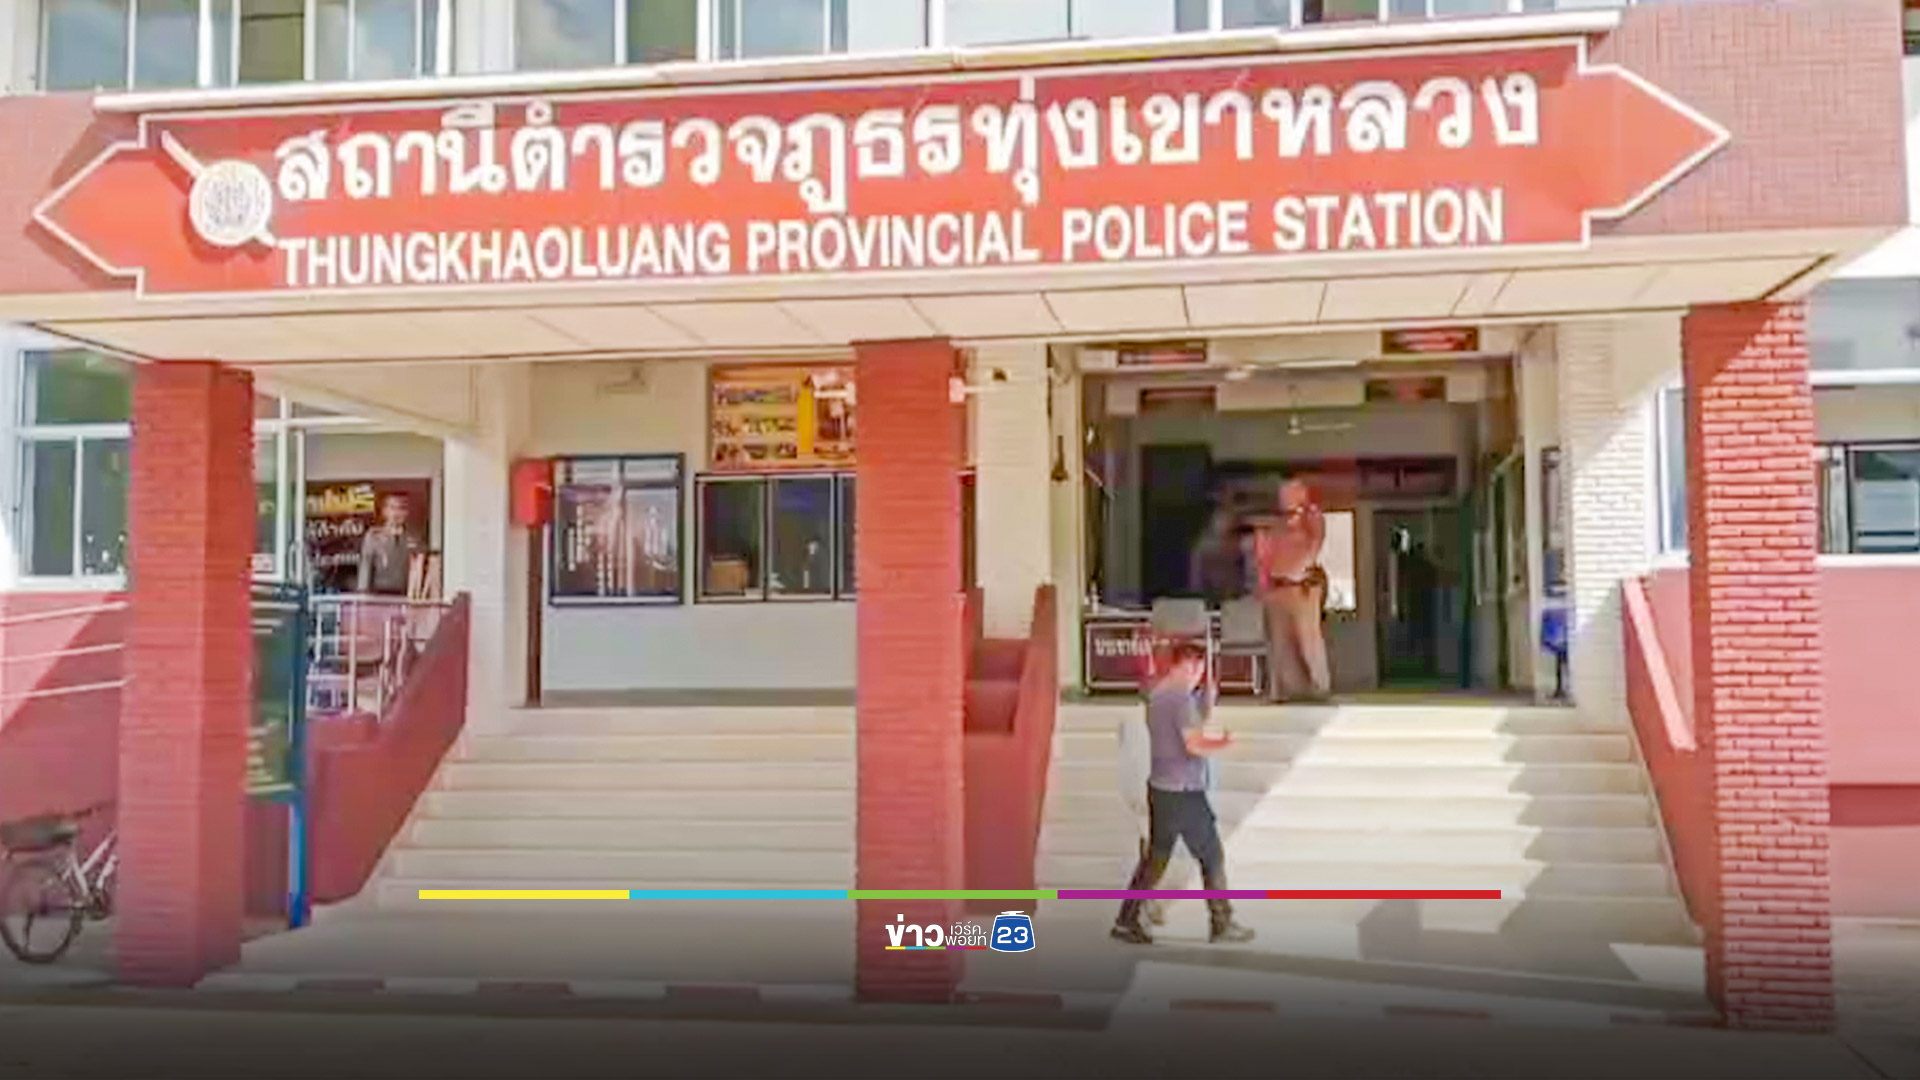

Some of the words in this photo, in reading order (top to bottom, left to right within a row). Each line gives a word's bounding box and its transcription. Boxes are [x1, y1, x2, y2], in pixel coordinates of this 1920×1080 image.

[275, 74, 1540, 214] สถานีตำรวจภูธรทุ่งเขาหลวง
[280, 221, 732, 286] THUNGKHAOLUANG
[746, 212, 1040, 272] PROVINCIAL
[1061, 202, 1248, 262] POLICE
[1273, 188, 1503, 251] STATION
